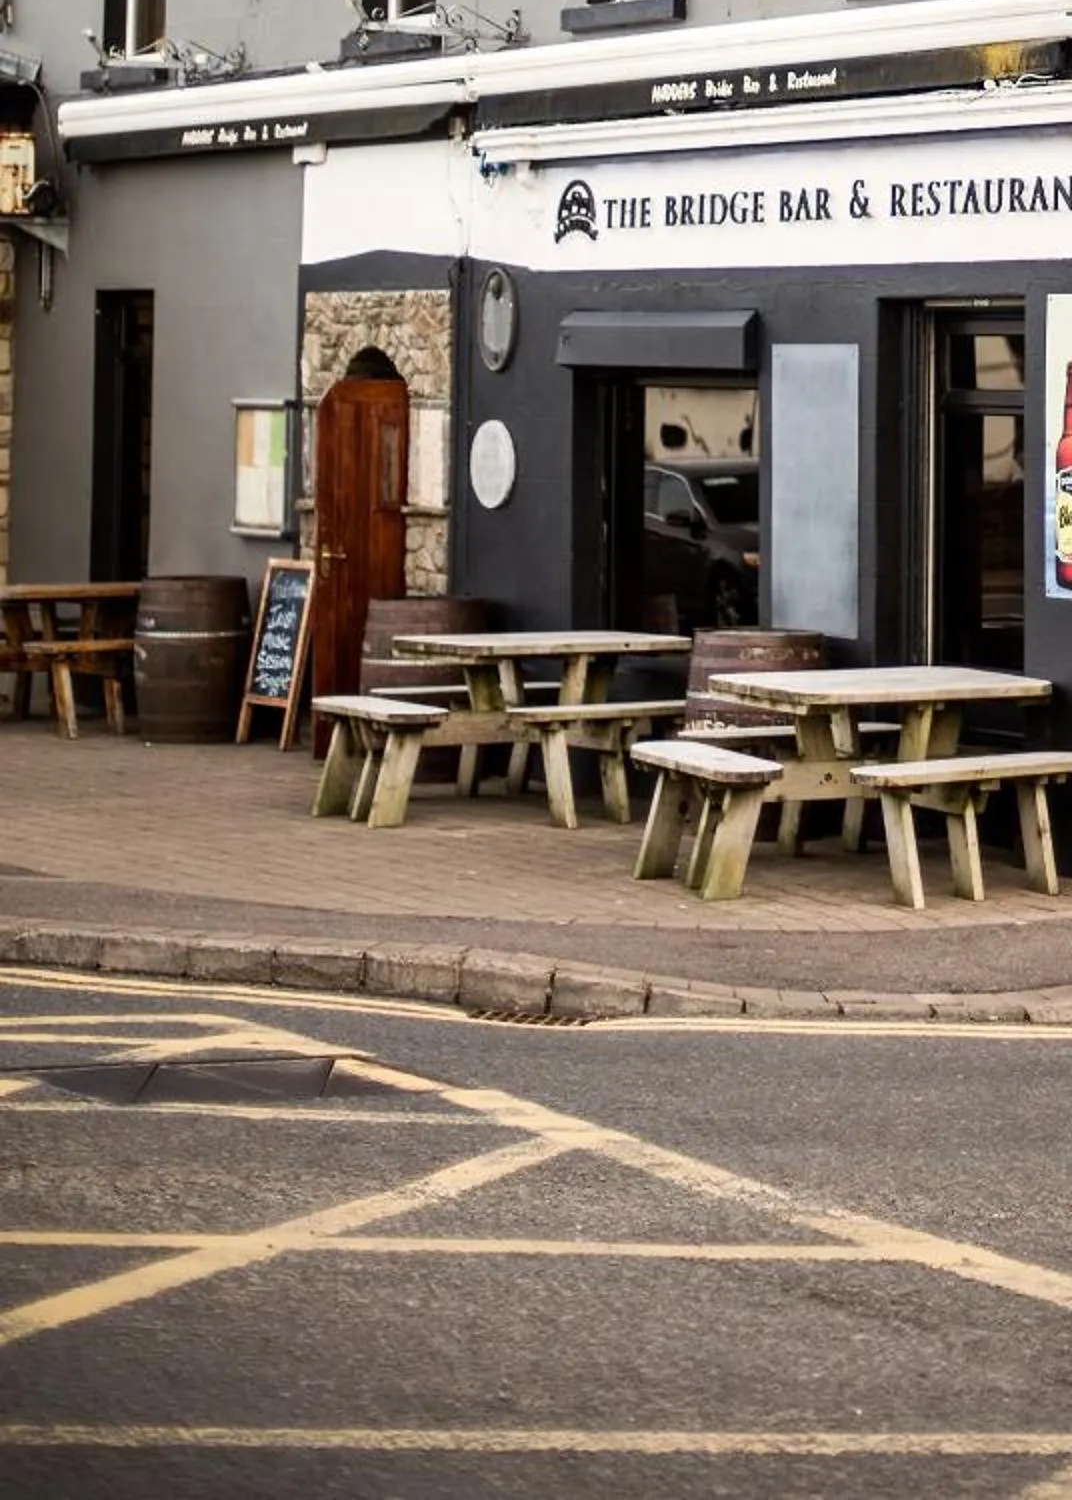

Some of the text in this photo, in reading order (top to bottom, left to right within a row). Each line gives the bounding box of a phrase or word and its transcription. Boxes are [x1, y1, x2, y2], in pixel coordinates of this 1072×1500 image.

[602, 197, 651, 229] THE
[664, 190, 765, 227] BRIDGE
[778, 187, 833, 223] BAR
[849, 179, 873, 219] &
